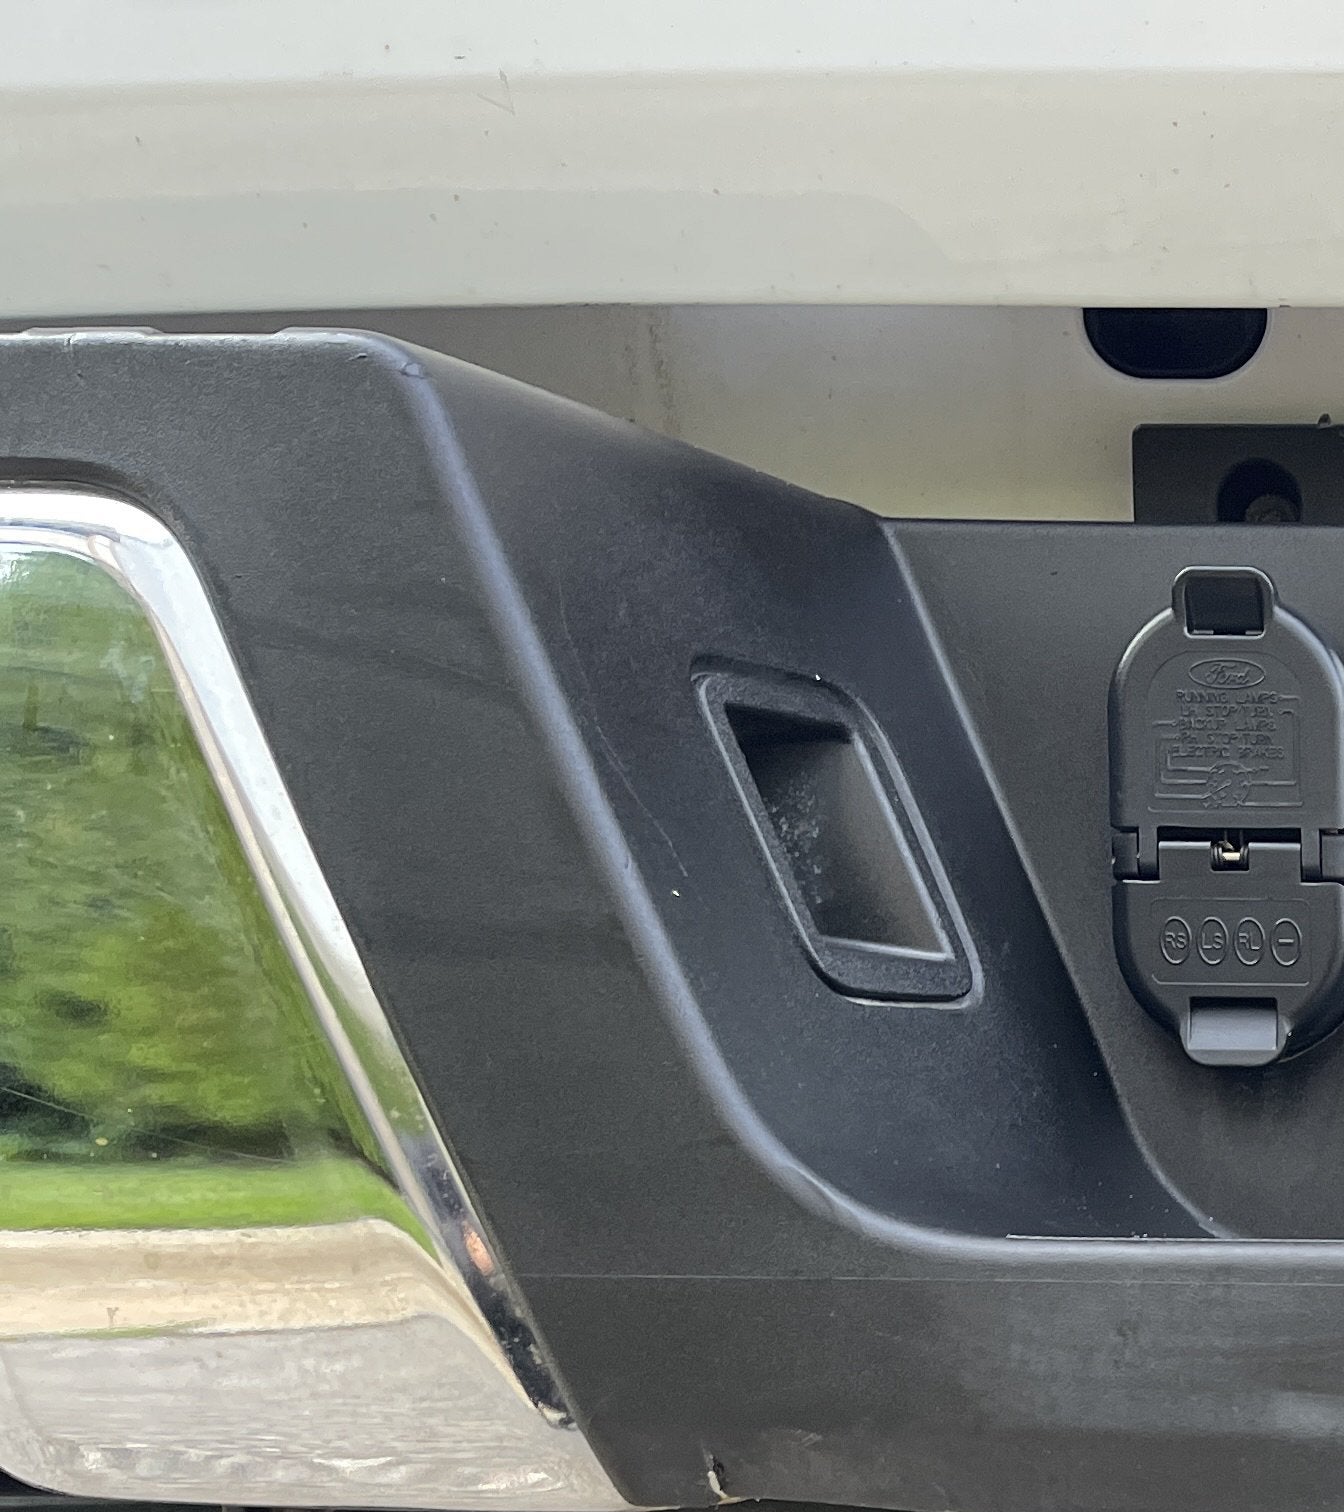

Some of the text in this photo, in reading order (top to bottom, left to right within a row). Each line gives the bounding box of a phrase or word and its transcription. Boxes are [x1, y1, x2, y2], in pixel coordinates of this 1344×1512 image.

[1205, 662, 1250, 685] Ford
[1165, 932, 1187, 949] RS
[1202, 932, 1223, 949] LS
[1238, 932, 1260, 950] RL
